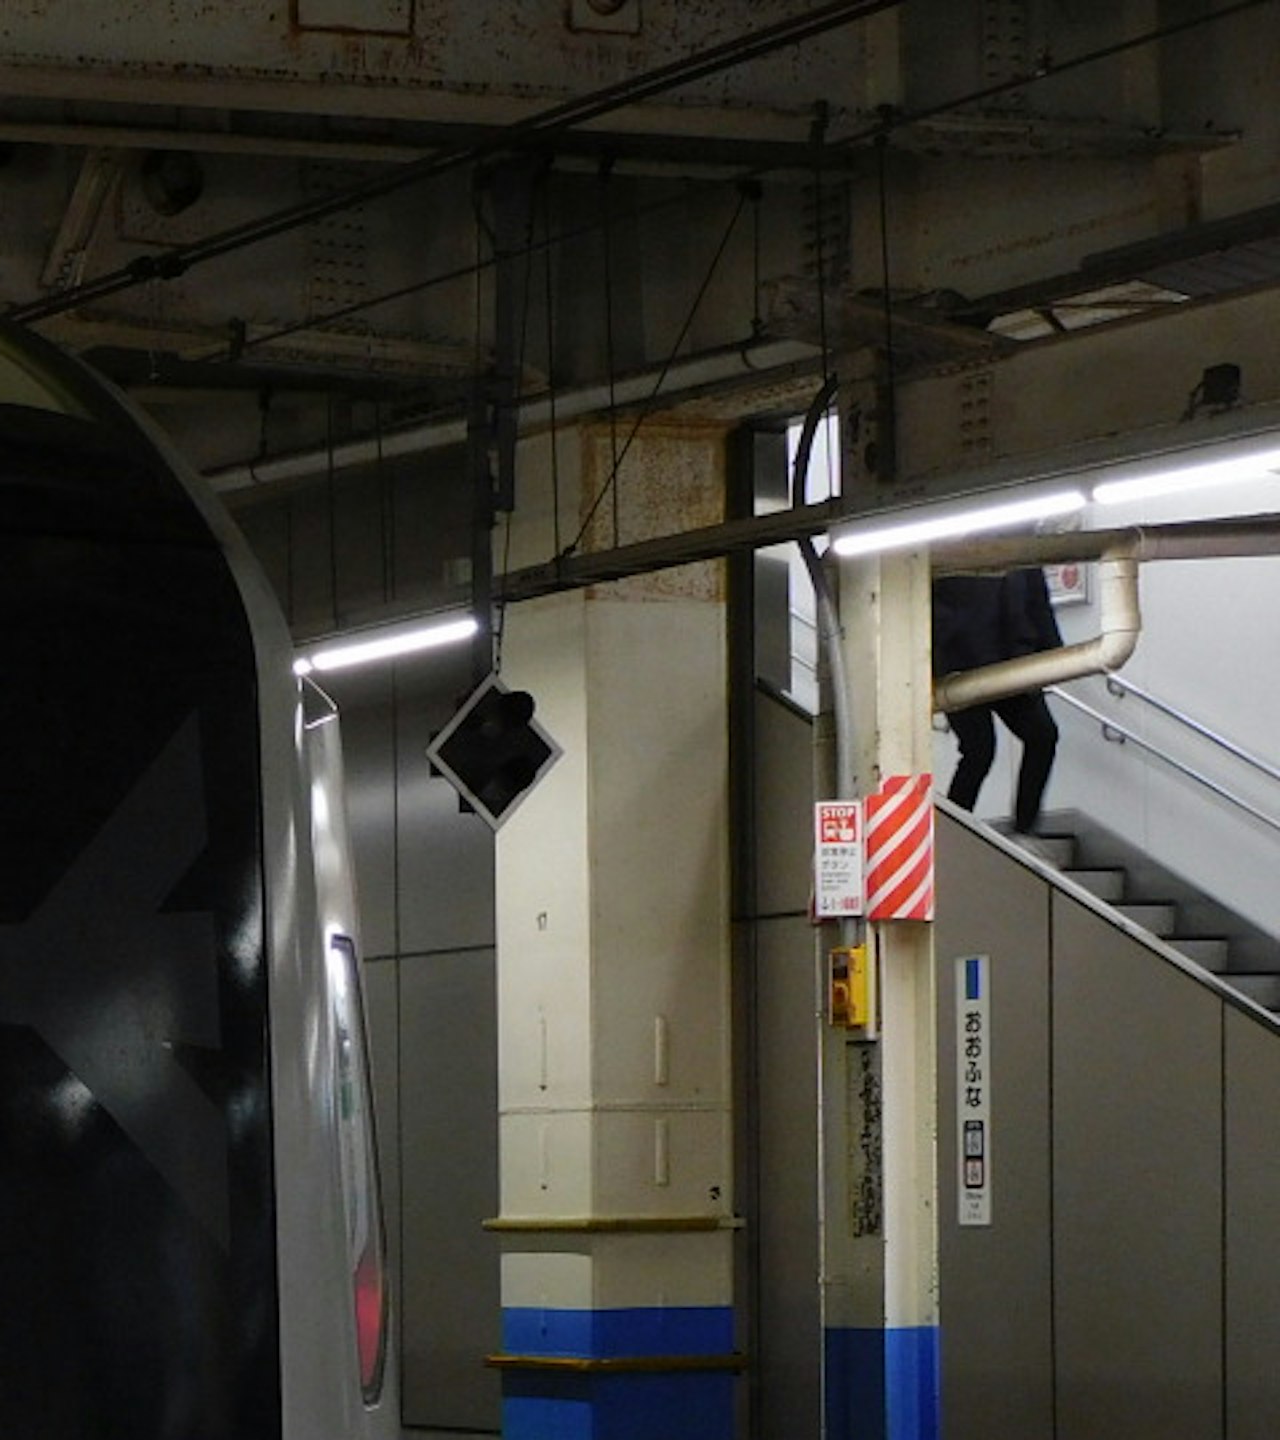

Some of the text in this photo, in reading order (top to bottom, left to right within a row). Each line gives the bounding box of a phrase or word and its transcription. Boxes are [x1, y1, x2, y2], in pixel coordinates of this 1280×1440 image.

[822, 807, 854, 819] STOP
[965, 1011, 982, 1106] おおふな
